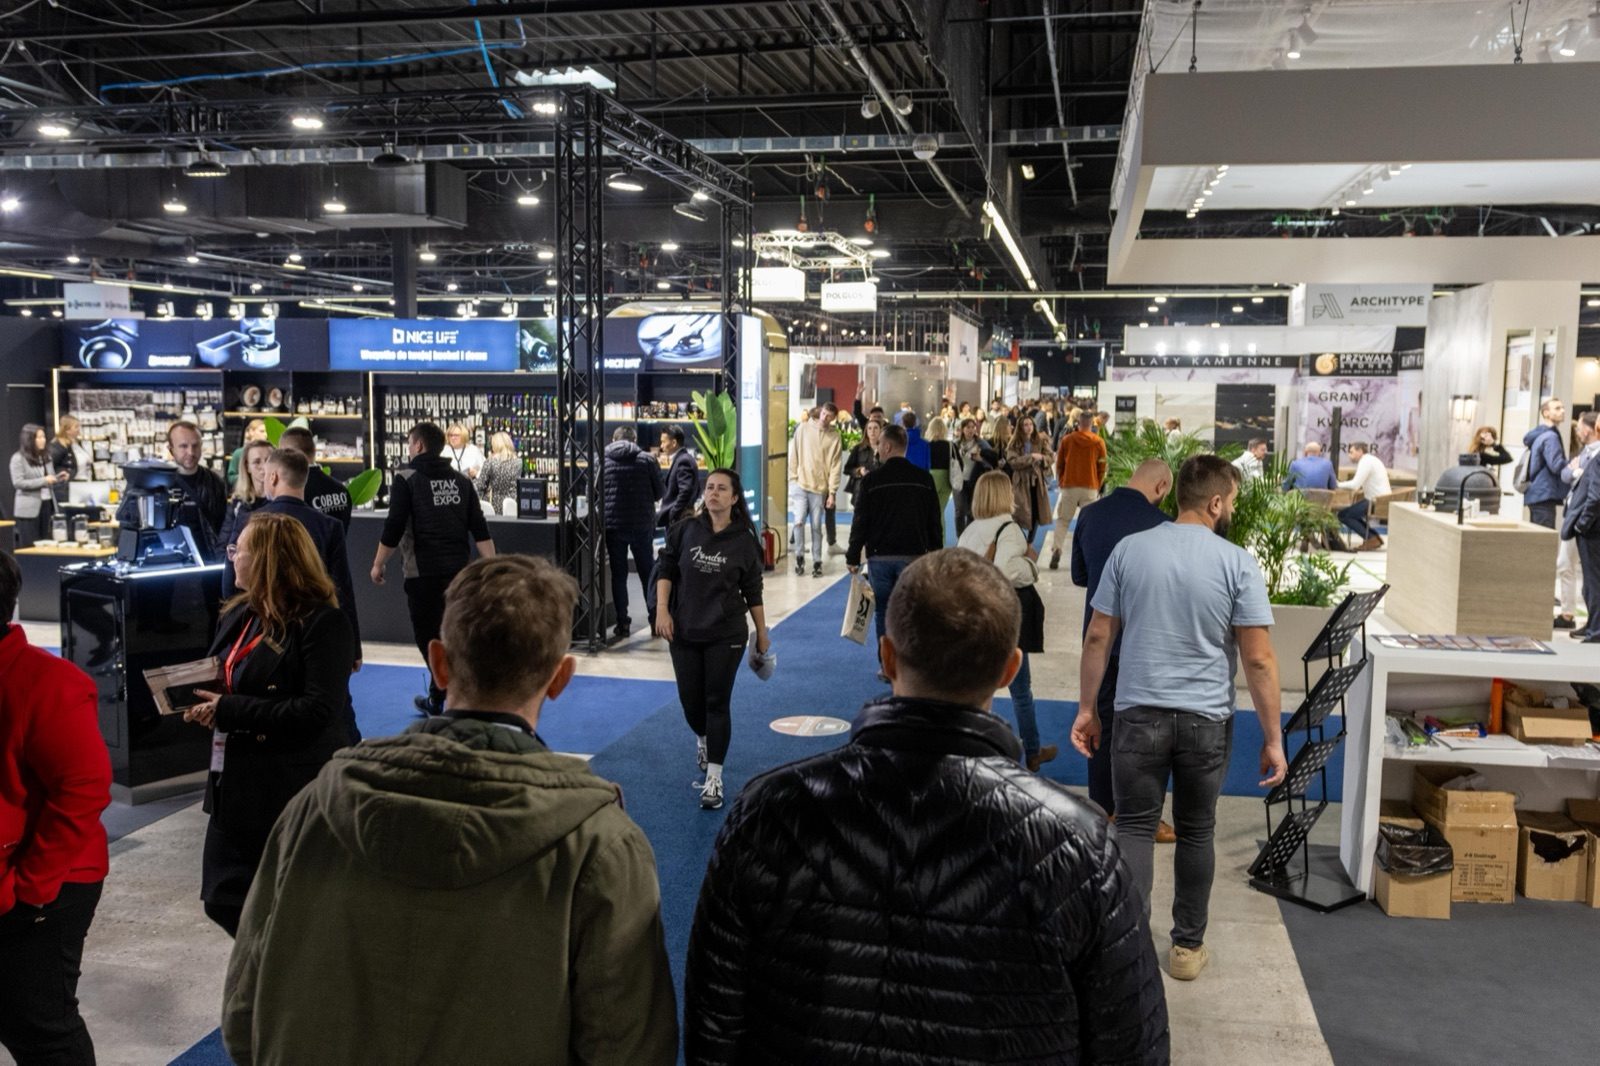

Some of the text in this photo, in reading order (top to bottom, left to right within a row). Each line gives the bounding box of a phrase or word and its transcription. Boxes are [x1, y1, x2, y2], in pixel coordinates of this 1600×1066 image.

[1350, 296, 1425, 306] ARCHITYPE
[406, 330, 457, 344] NICE LIFE
[1129, 357, 1282, 367] BLATY KAMIENNE
[1318, 391, 1371, 402] GRANIT
[430, 479, 458, 490] PTAK
[312, 492, 348, 510] COBBO
[433, 495, 462, 506] EXPO
[689, 546, 728, 564] Fender
